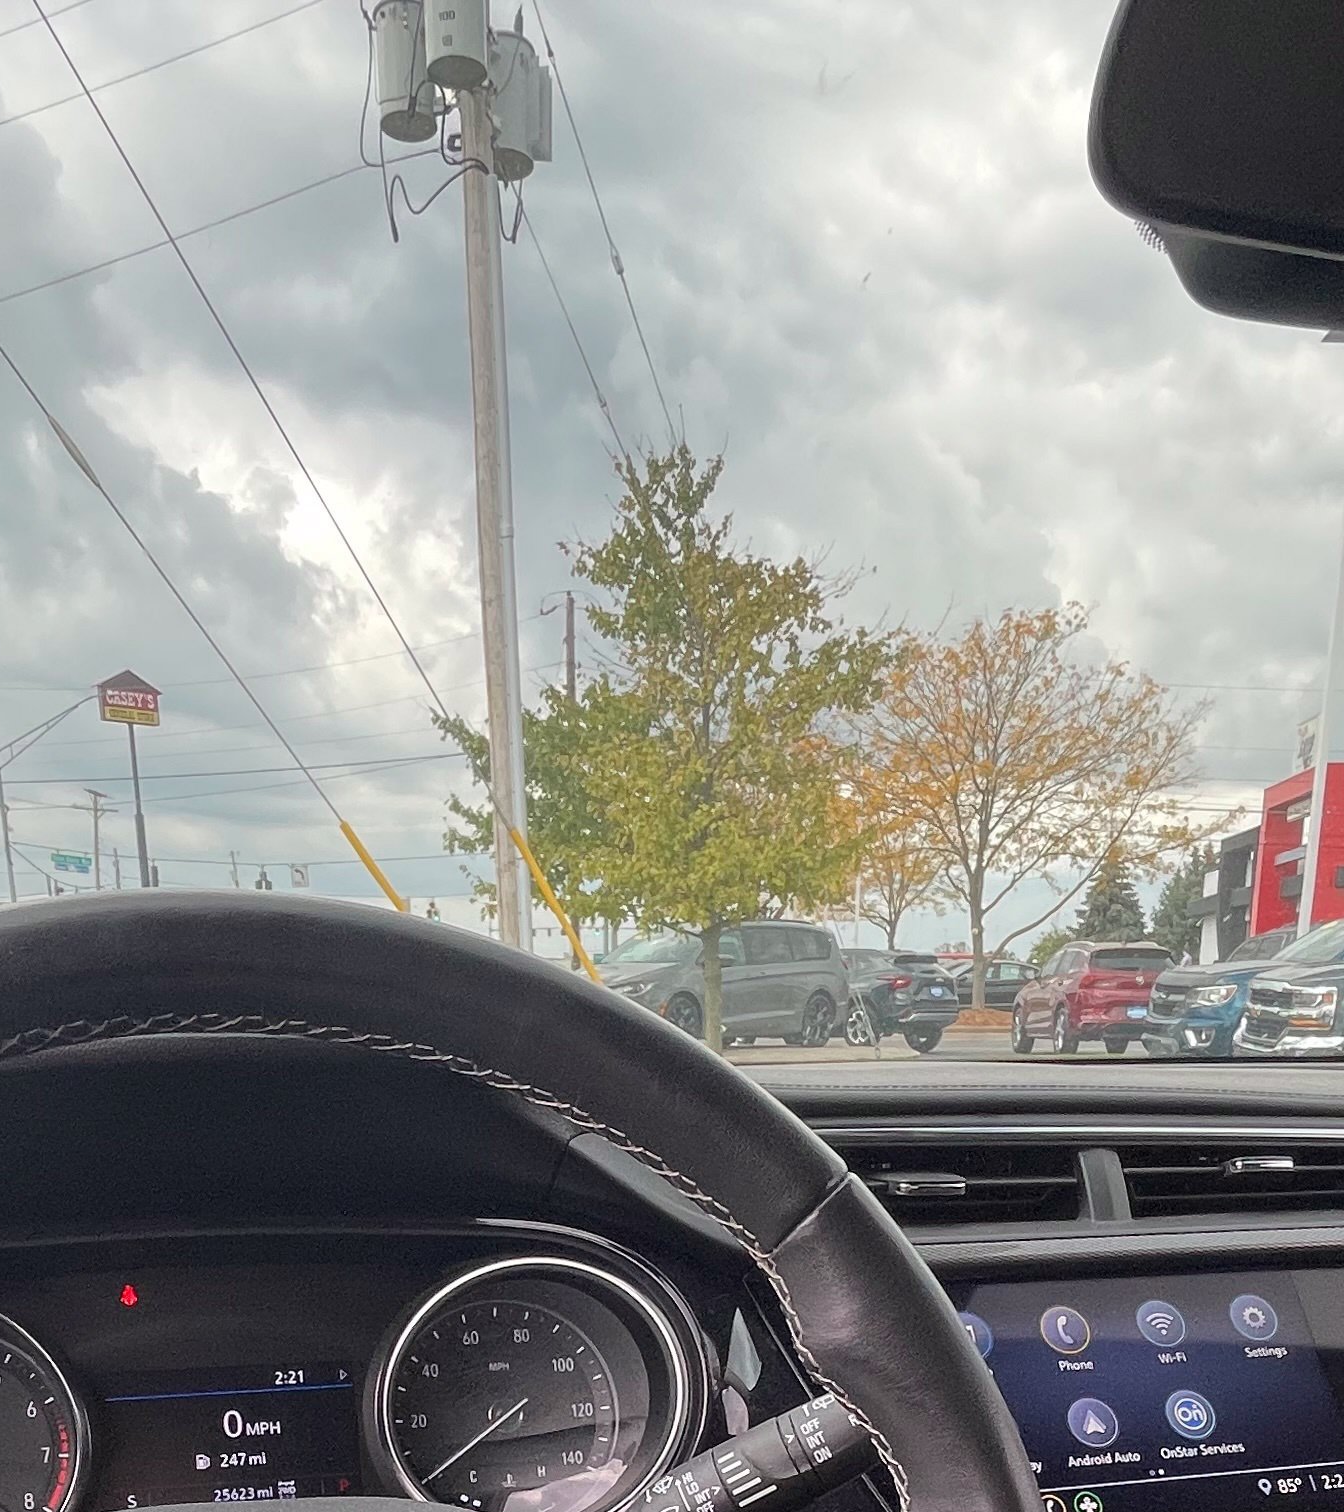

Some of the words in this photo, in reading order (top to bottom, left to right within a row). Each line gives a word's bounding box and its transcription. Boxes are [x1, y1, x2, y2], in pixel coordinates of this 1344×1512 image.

[105, 689, 155, 709] CASEY'S
[462, 1330, 480, 1345] 60
[513, 1328, 531, 1343] 80
[1157, 1351, 1188, 1364] Wi-Fi
[1244, 1346, 1288, 1359] Settings
[421, 1363, 440, 1378] 40
[488, 1362, 510, 1372] MPH
[551, 1357, 575, 1372] 100
[1058, 1359, 1095, 1372] Phone
[274, 1369, 305, 1386] 2:21
[26, 1400, 38, 1418] 6
[571, 1402, 594, 1418] 120
[223, 1409, 244, 1439] 0
[246, 1420, 282, 1437] MPH
[410, 1414, 428, 1430] 20
[800, 1417, 821, 1435] OFF
[805, 1431, 826, 1449] INT
[40, 1446, 51, 1464] 7
[561, 1450, 584, 1466] 140
[813, 1447, 834, 1464] ON
[1160, 1444, 1198, 1460] OnStar
[1199, 1442, 1246, 1457] Services
[219, 1452, 247, 1469] 247
[248, 1451, 268, 1467] mi
[1068, 1453, 1114, 1469] Android
[1114, 1451, 1142, 1465] Auto
[469, 1470, 478, 1483] C
[536, 1465, 546, 1478] H
[682, 1471, 695, 1485] HI
[339, 1478, 350, 1492] P
[685, 1481, 701, 1495] LO
[24, 1492, 35, 1511] 8
[127, 1494, 138, 1509] S
[213, 1486, 256, 1502] 25623
[257, 1486, 274, 1499] mi
[694, 1488, 712, 1505] INT
